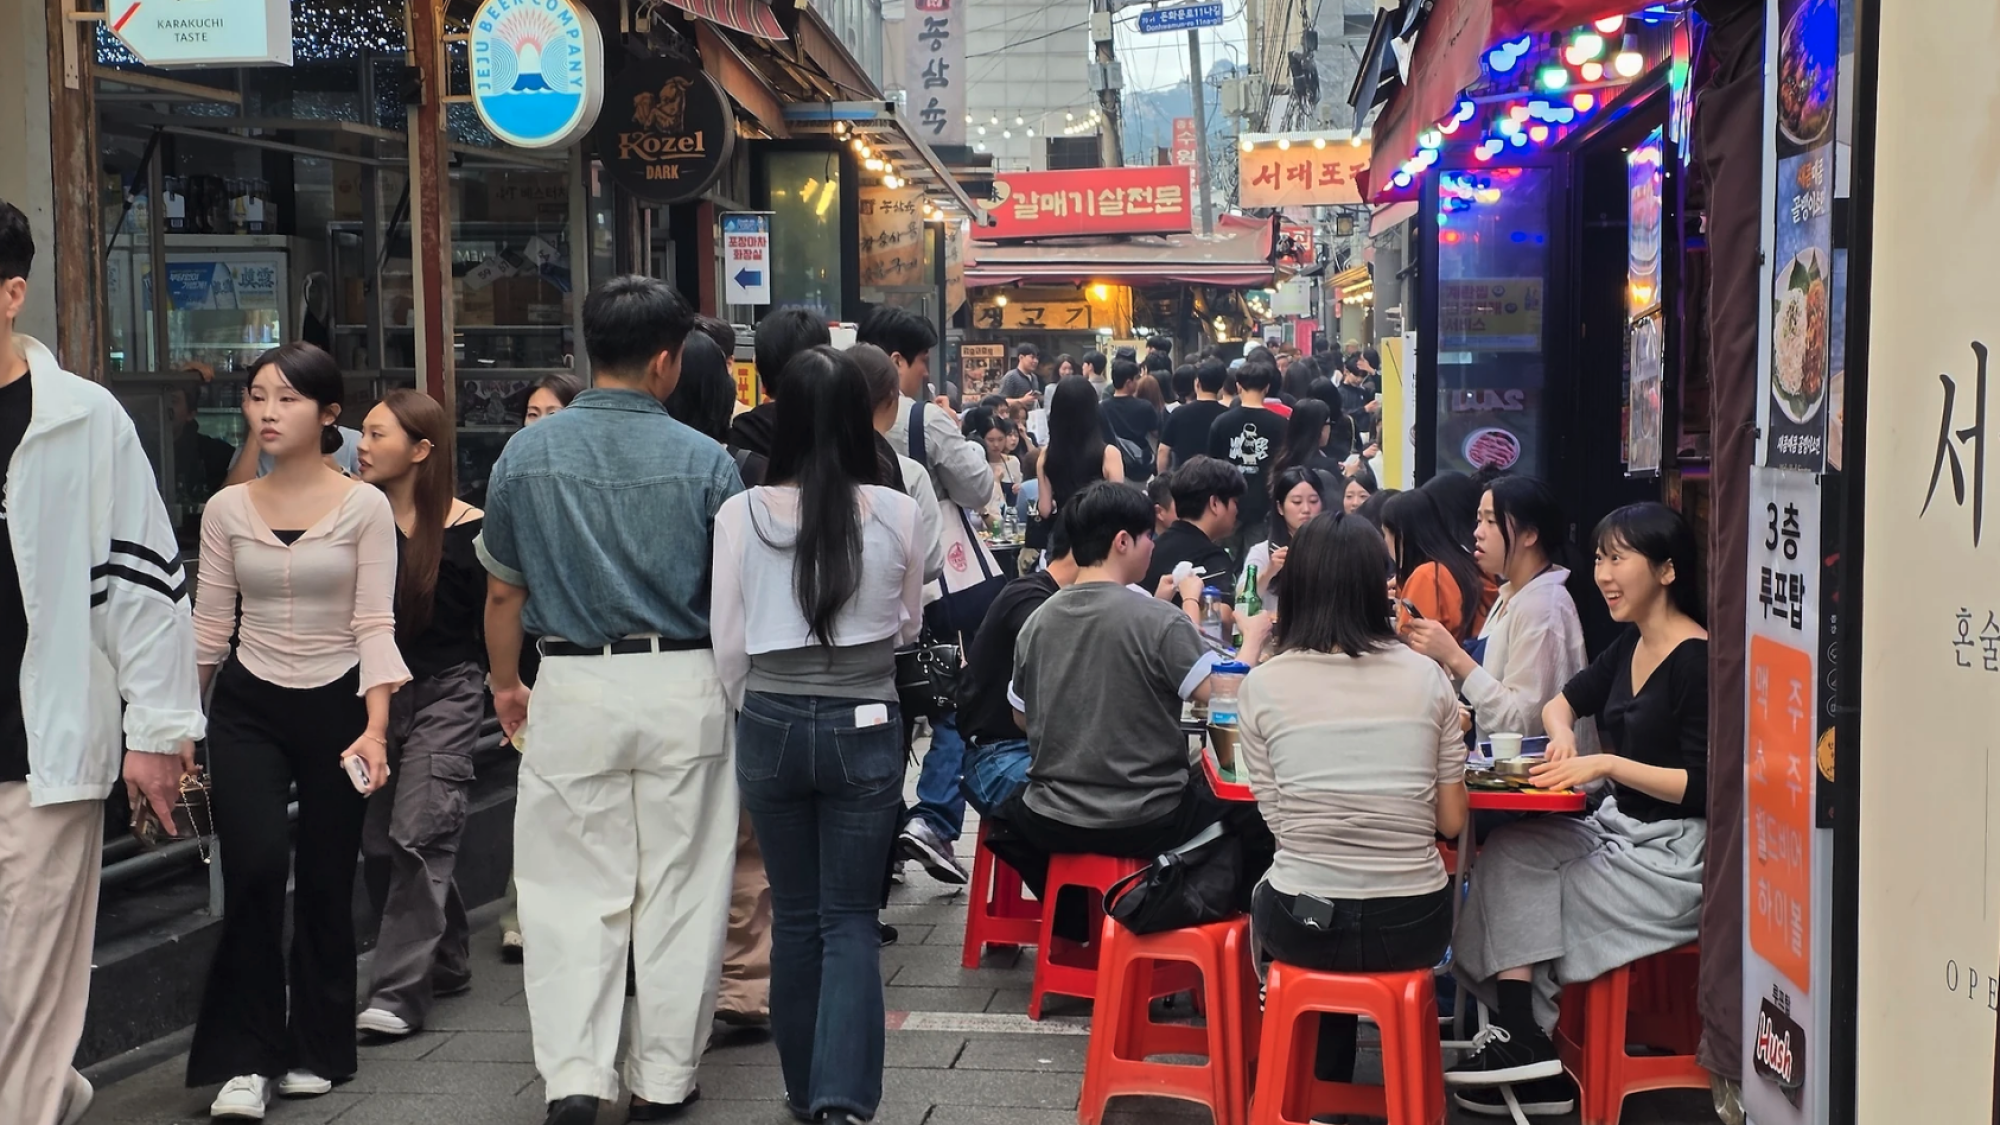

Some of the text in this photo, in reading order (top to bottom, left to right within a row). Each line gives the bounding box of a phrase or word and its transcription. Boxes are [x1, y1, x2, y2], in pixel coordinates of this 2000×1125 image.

[157, 18, 224, 29] KARAKUCHI
[1160, 5, 1221, 23] 돈화문로11나길
[174, 32, 208, 42] TASTE
[476, 41, 491, 90] JEJU
[618, 130, 706, 161] Kozel
[646, 164, 680, 180] DARK
[1012, 185, 1183, 220] 갈매기살전문
[728, 235, 767, 248] 포장마차
[733, 248, 763, 261] 화장실
[1765, 501, 1801, 561] 3층
[1759, 565, 1805, 631] 루프탑
[1952, 606, 2000, 672] 혼술
[1758, 875, 1803, 958] 하이볼
[1946, 959, 1997, 1011] OPE
[1757, 1010, 1793, 1083] Hush
